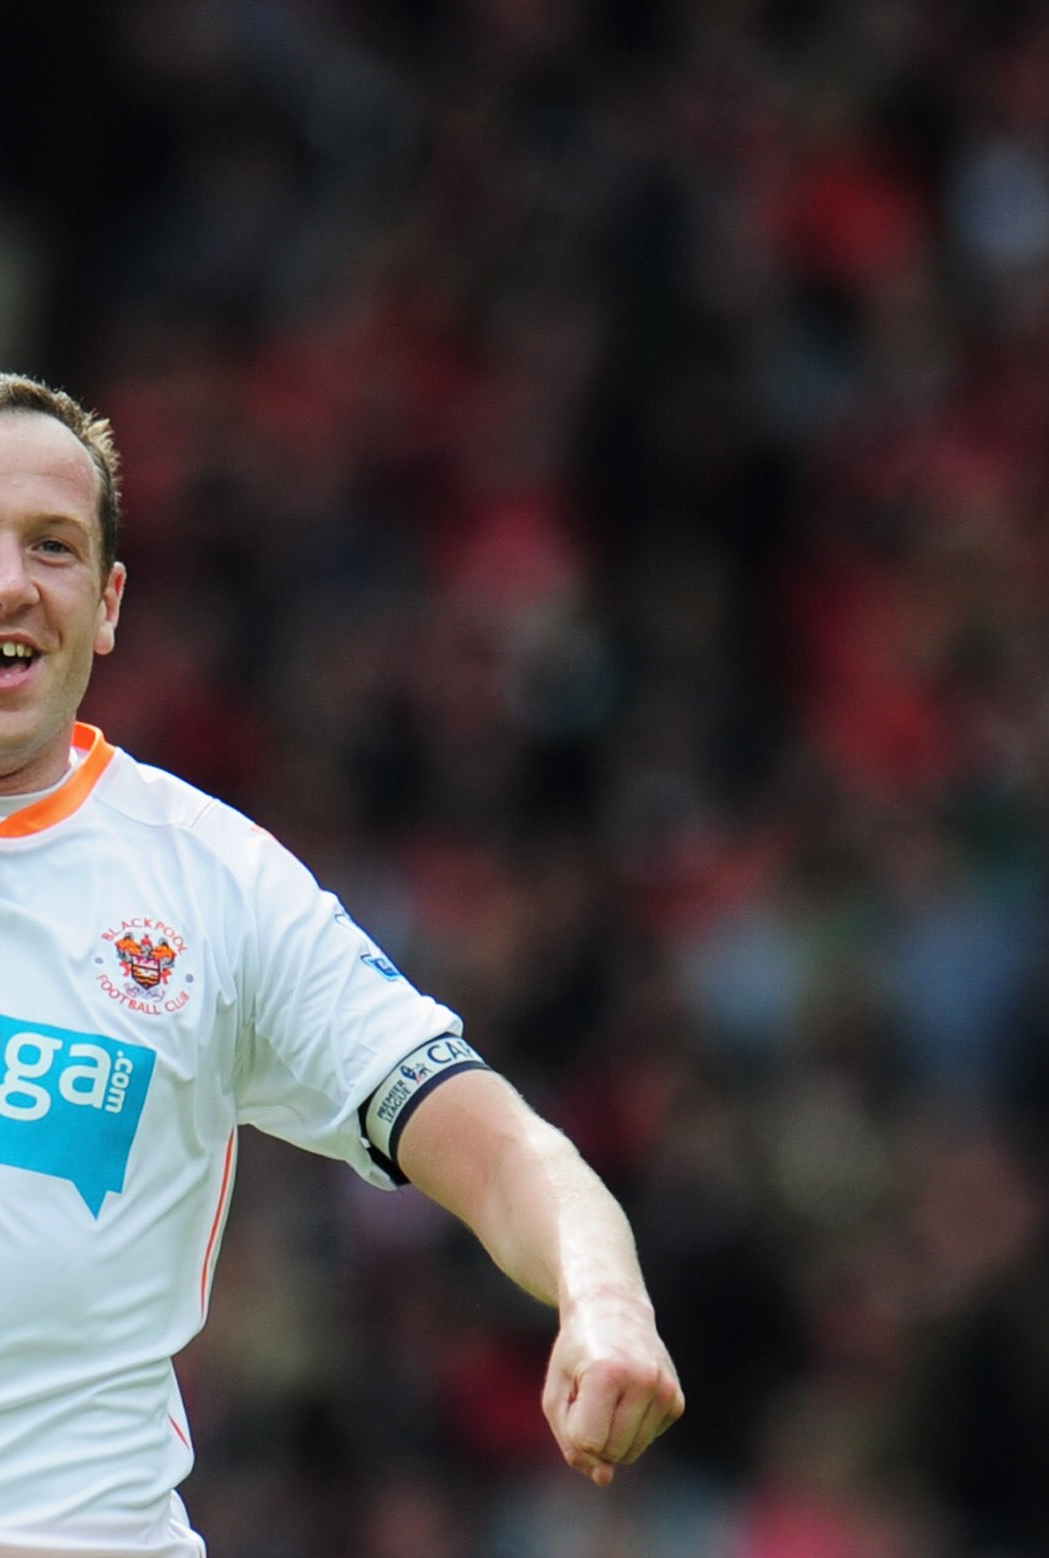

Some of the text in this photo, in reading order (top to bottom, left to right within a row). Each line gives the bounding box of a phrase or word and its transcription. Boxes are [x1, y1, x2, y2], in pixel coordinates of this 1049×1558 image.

[101, 918, 187, 955] BLACKPOOL
[96, 975, 162, 1015] FOOTBALL
[164, 991, 190, 1012] CLUB
[105, 1050, 134, 1114] .com
